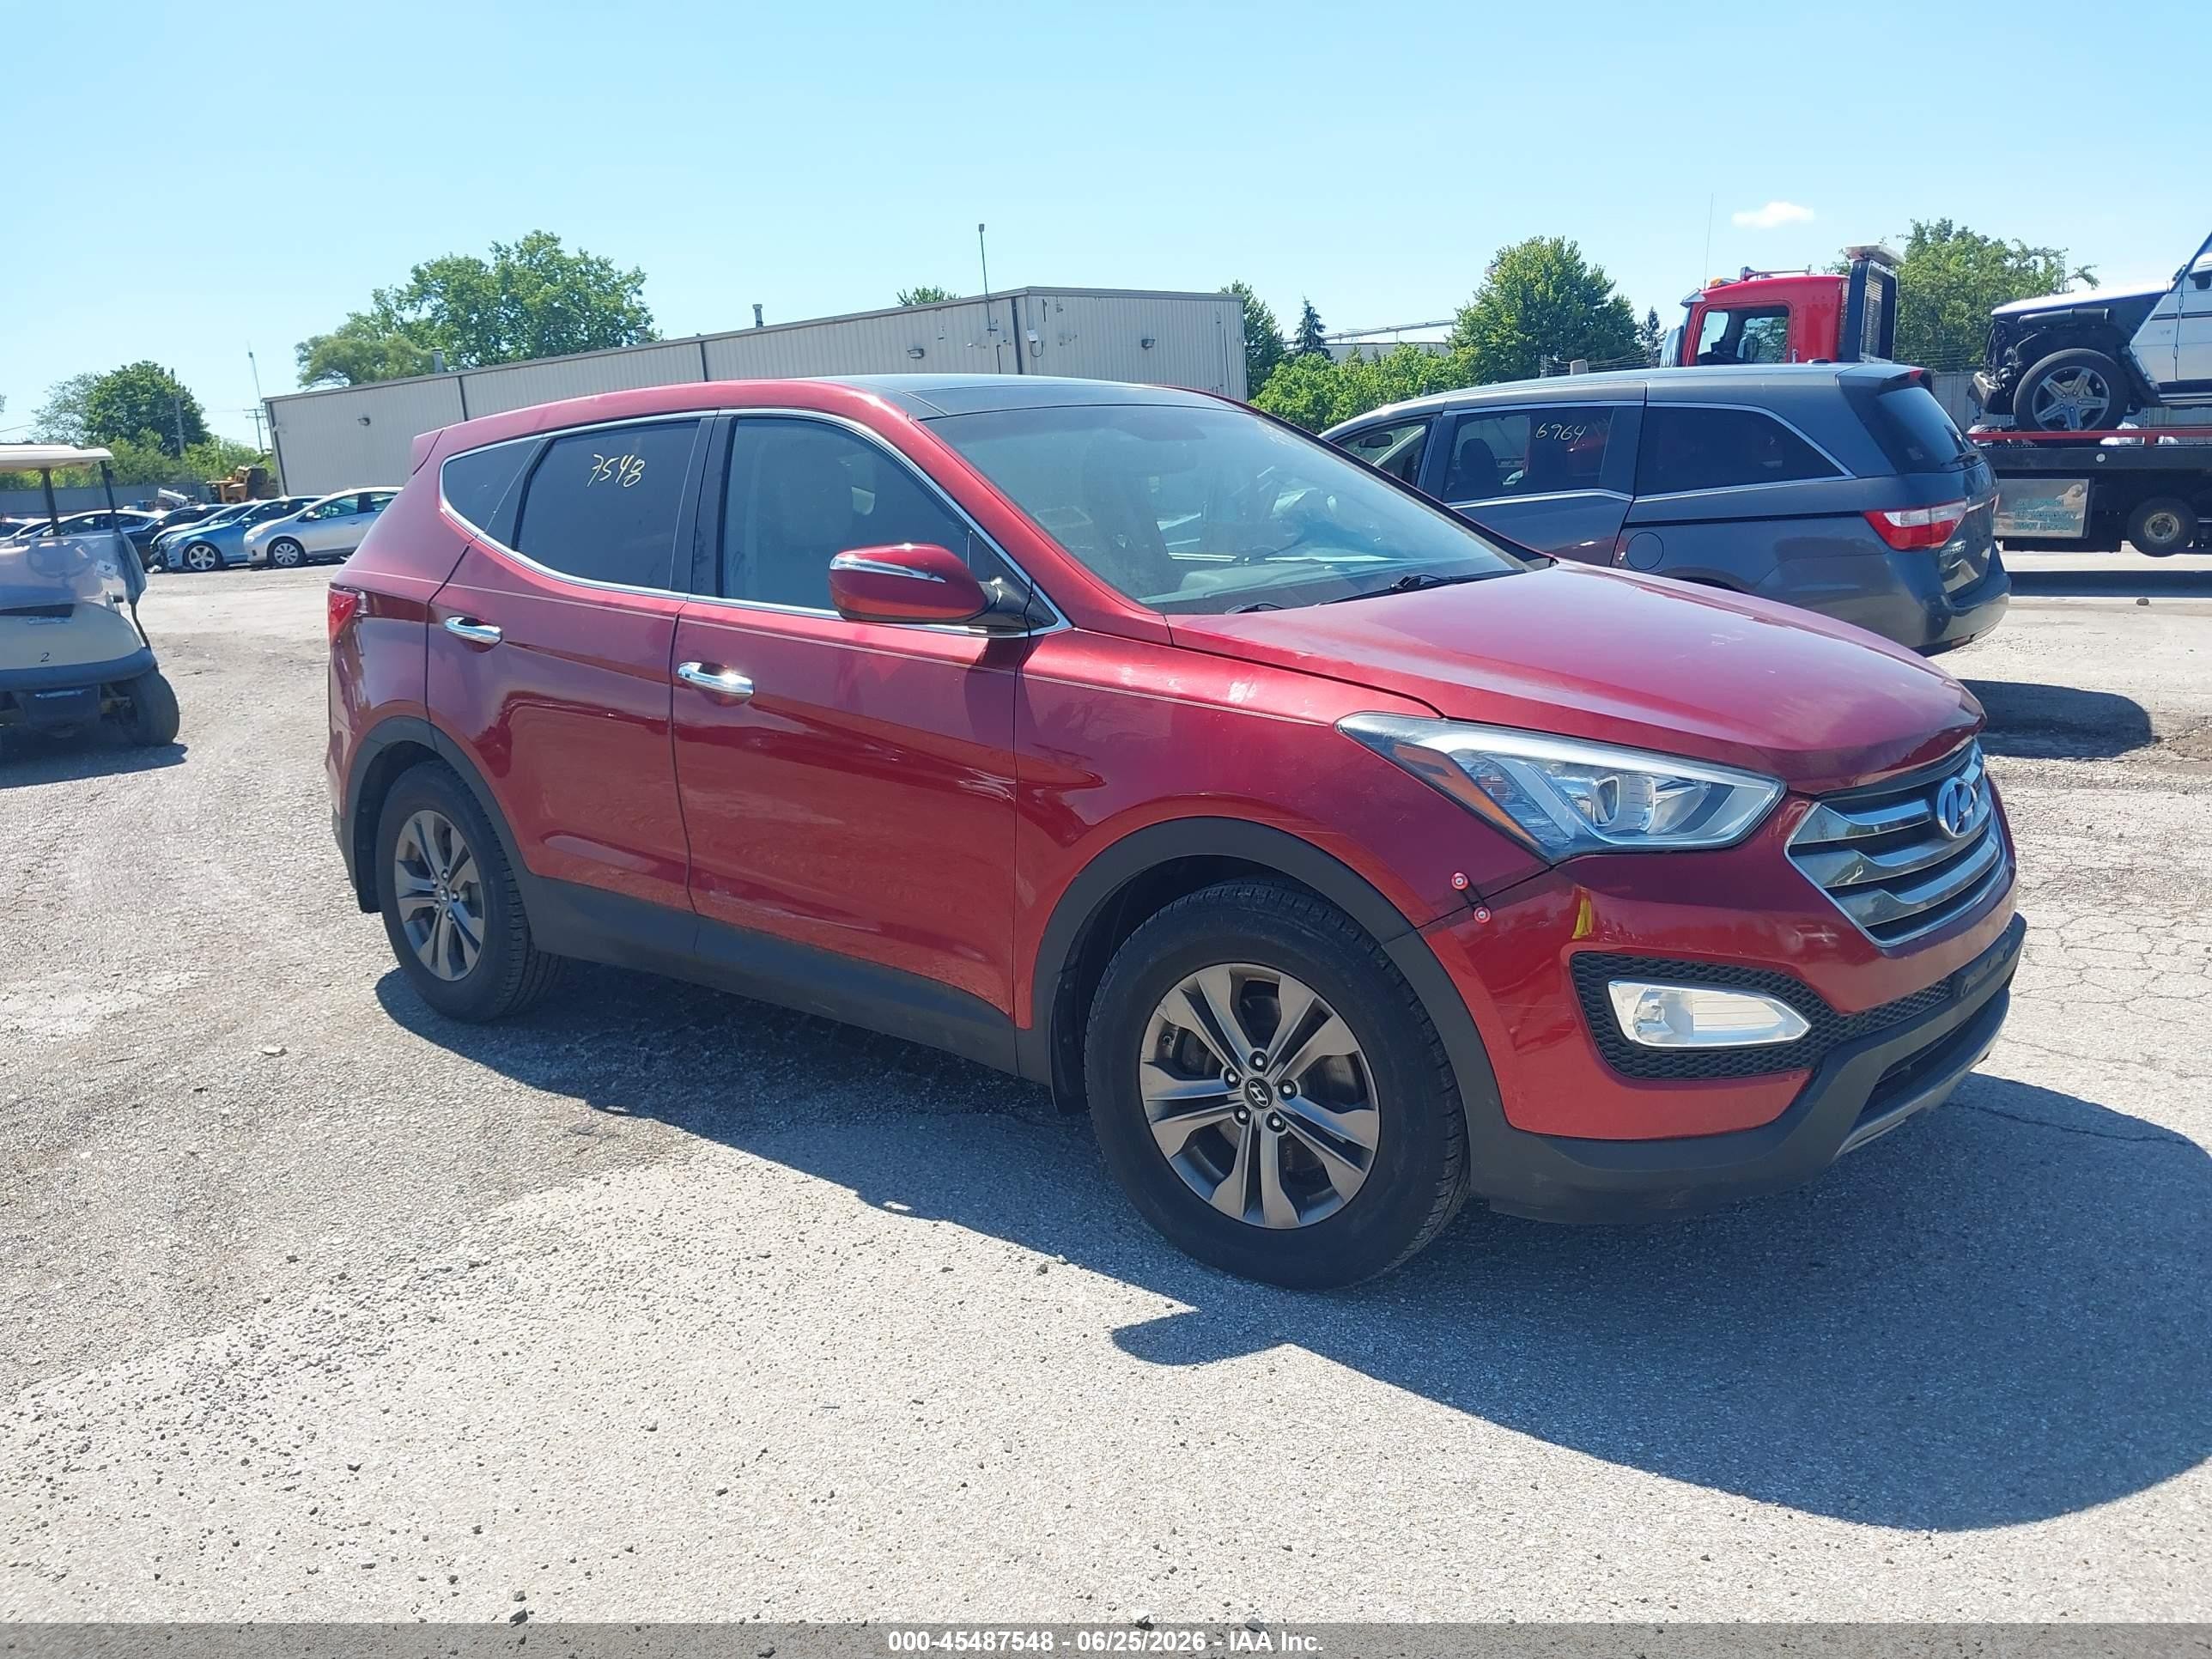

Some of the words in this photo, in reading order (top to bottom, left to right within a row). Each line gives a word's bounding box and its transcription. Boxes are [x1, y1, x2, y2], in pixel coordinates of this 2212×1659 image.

[1535, 422, 1587, 445] 6964
[586, 453, 646, 488] 7548
[40, 652, 50, 663] 2
